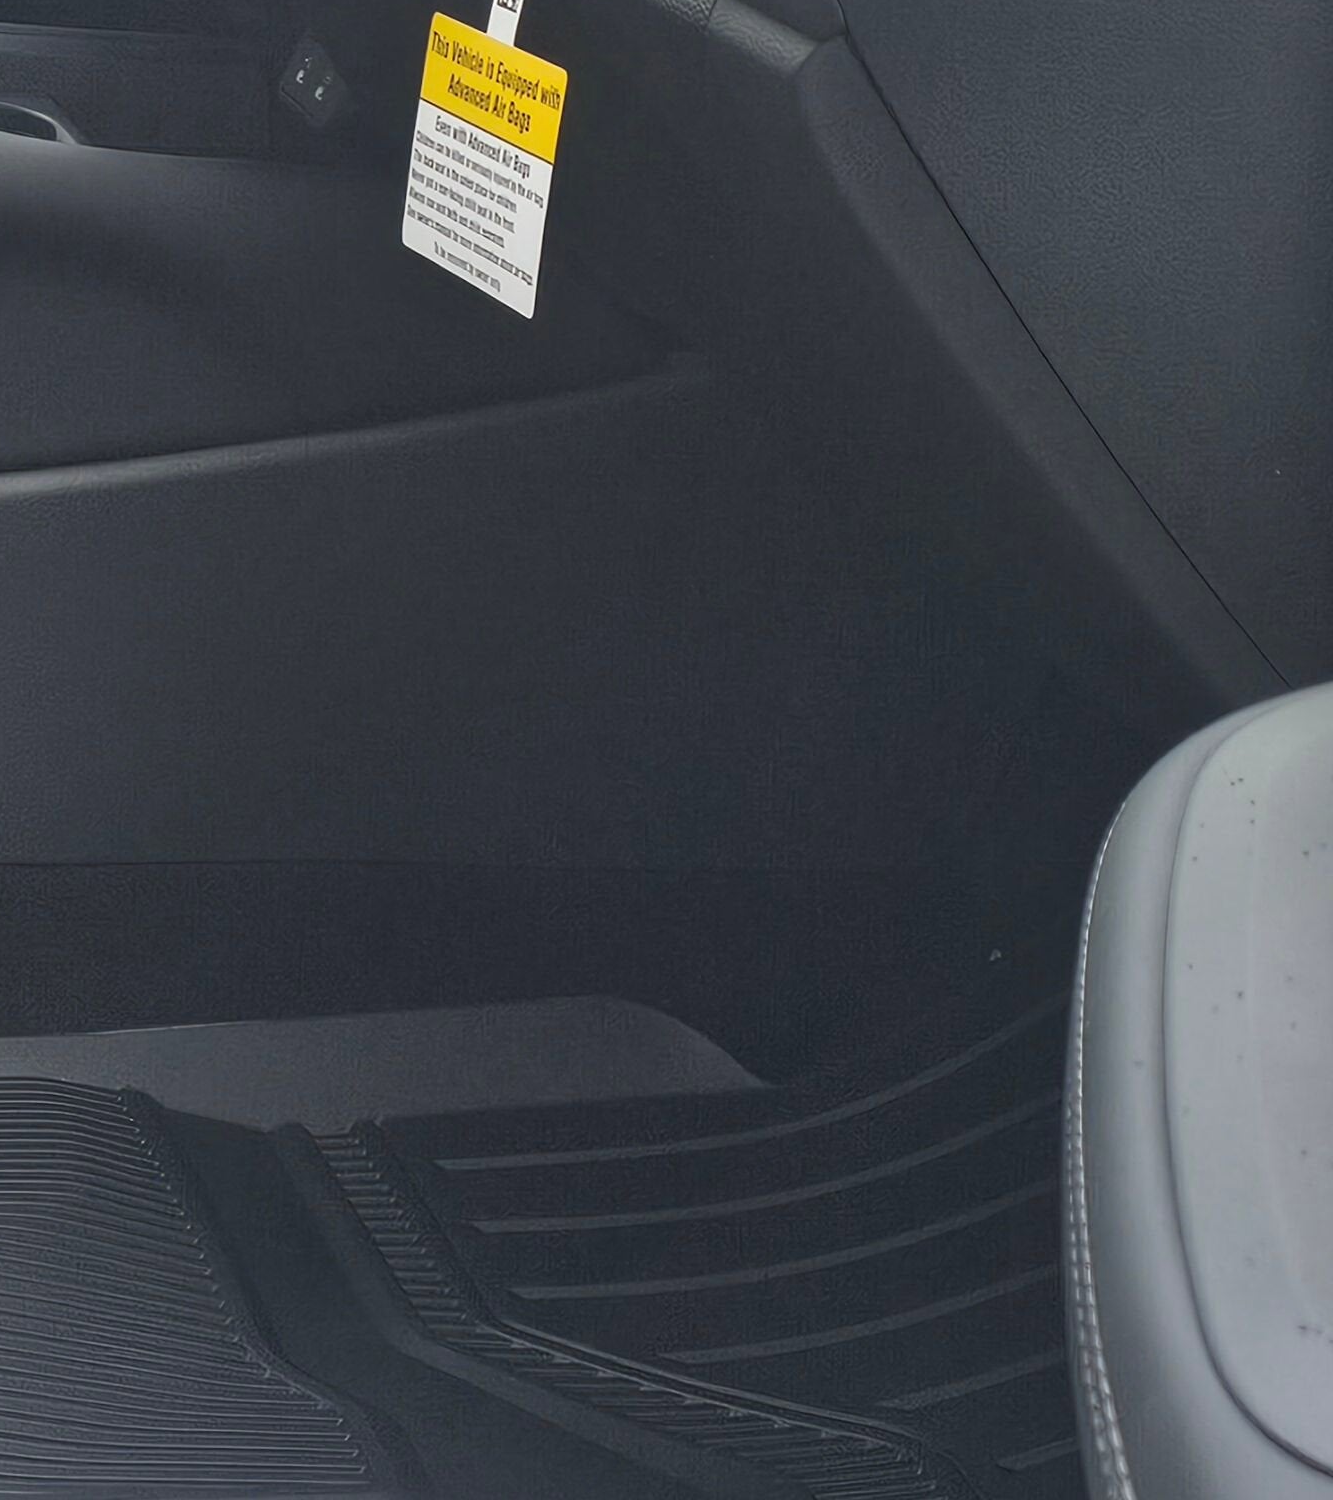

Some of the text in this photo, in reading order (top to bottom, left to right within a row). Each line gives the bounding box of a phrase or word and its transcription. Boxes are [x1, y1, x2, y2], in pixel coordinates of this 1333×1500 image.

[431, 31, 561, 110] This Vehicle is Equipped with
[448, 73, 531, 133] Advanced Air Bags
[468, 132, 501, 162] Advanced
